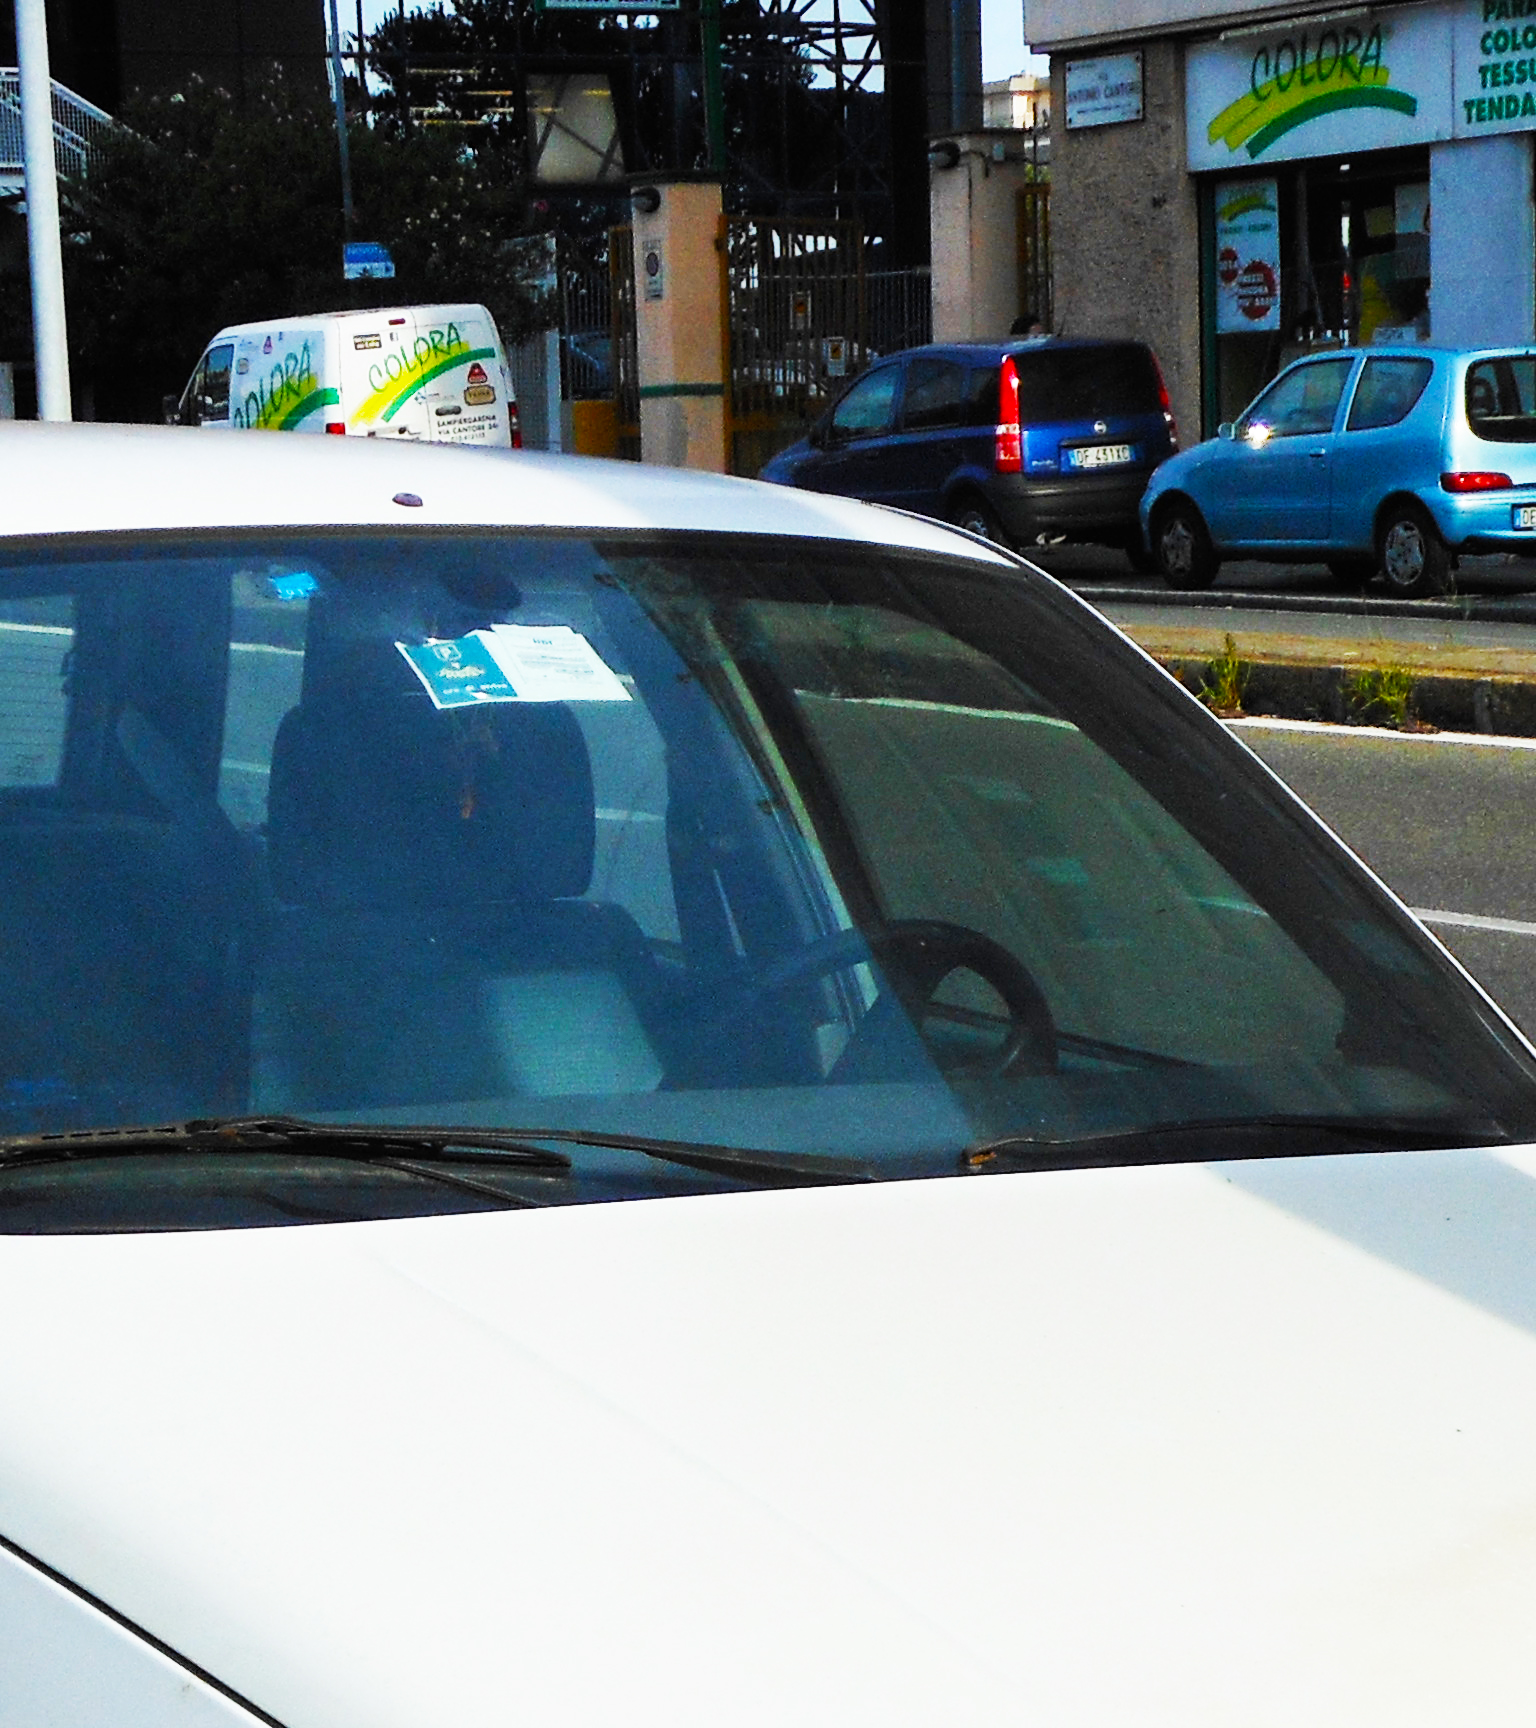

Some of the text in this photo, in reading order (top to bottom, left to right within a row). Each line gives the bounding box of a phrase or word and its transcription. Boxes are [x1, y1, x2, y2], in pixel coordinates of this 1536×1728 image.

[1250, 23, 1382, 102] COLORA
[368, 322, 462, 393] COLORA
[1523, 509, 1536, 525] DE
